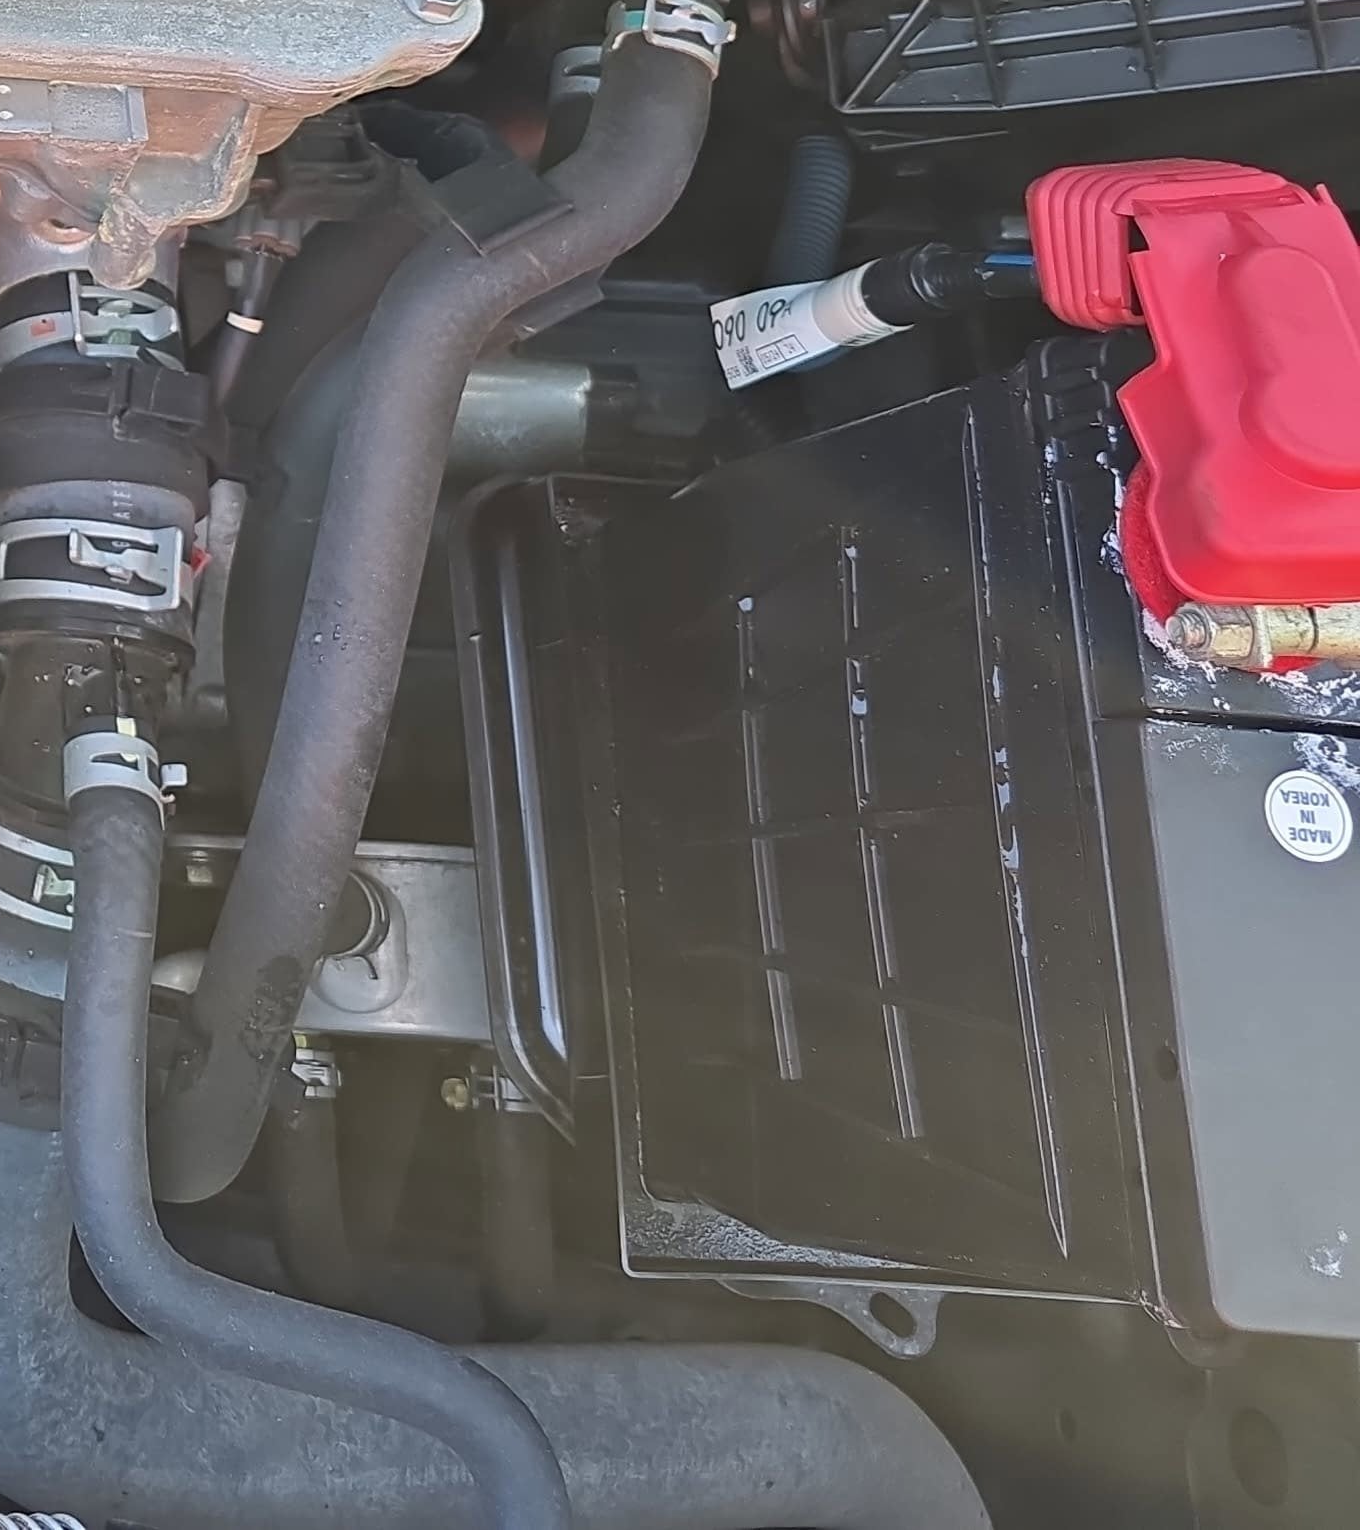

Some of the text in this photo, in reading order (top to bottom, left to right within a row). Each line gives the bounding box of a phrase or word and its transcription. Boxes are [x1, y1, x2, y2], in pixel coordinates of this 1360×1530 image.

[1280, 789, 1330, 807] KOREA
[1299, 809, 1316, 825] IN
[1288, 827, 1333, 844] MADE
